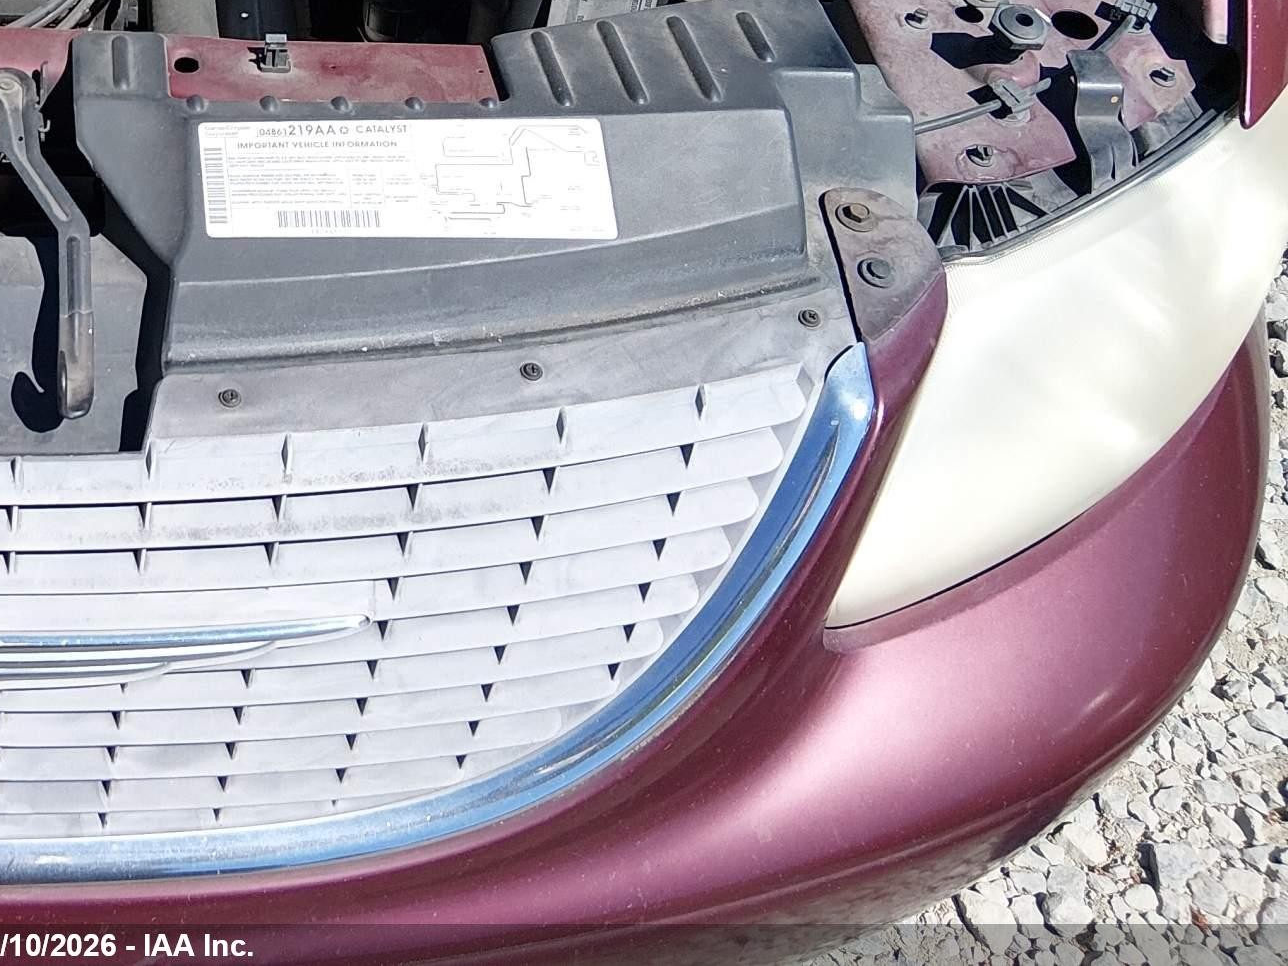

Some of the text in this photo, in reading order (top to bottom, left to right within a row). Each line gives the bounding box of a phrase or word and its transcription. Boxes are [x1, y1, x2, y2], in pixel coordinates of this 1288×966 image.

[355, 124, 408, 134] CATALYST
[237, 140, 399, 149] IMPORTANT VEHICLE INFORMATION
